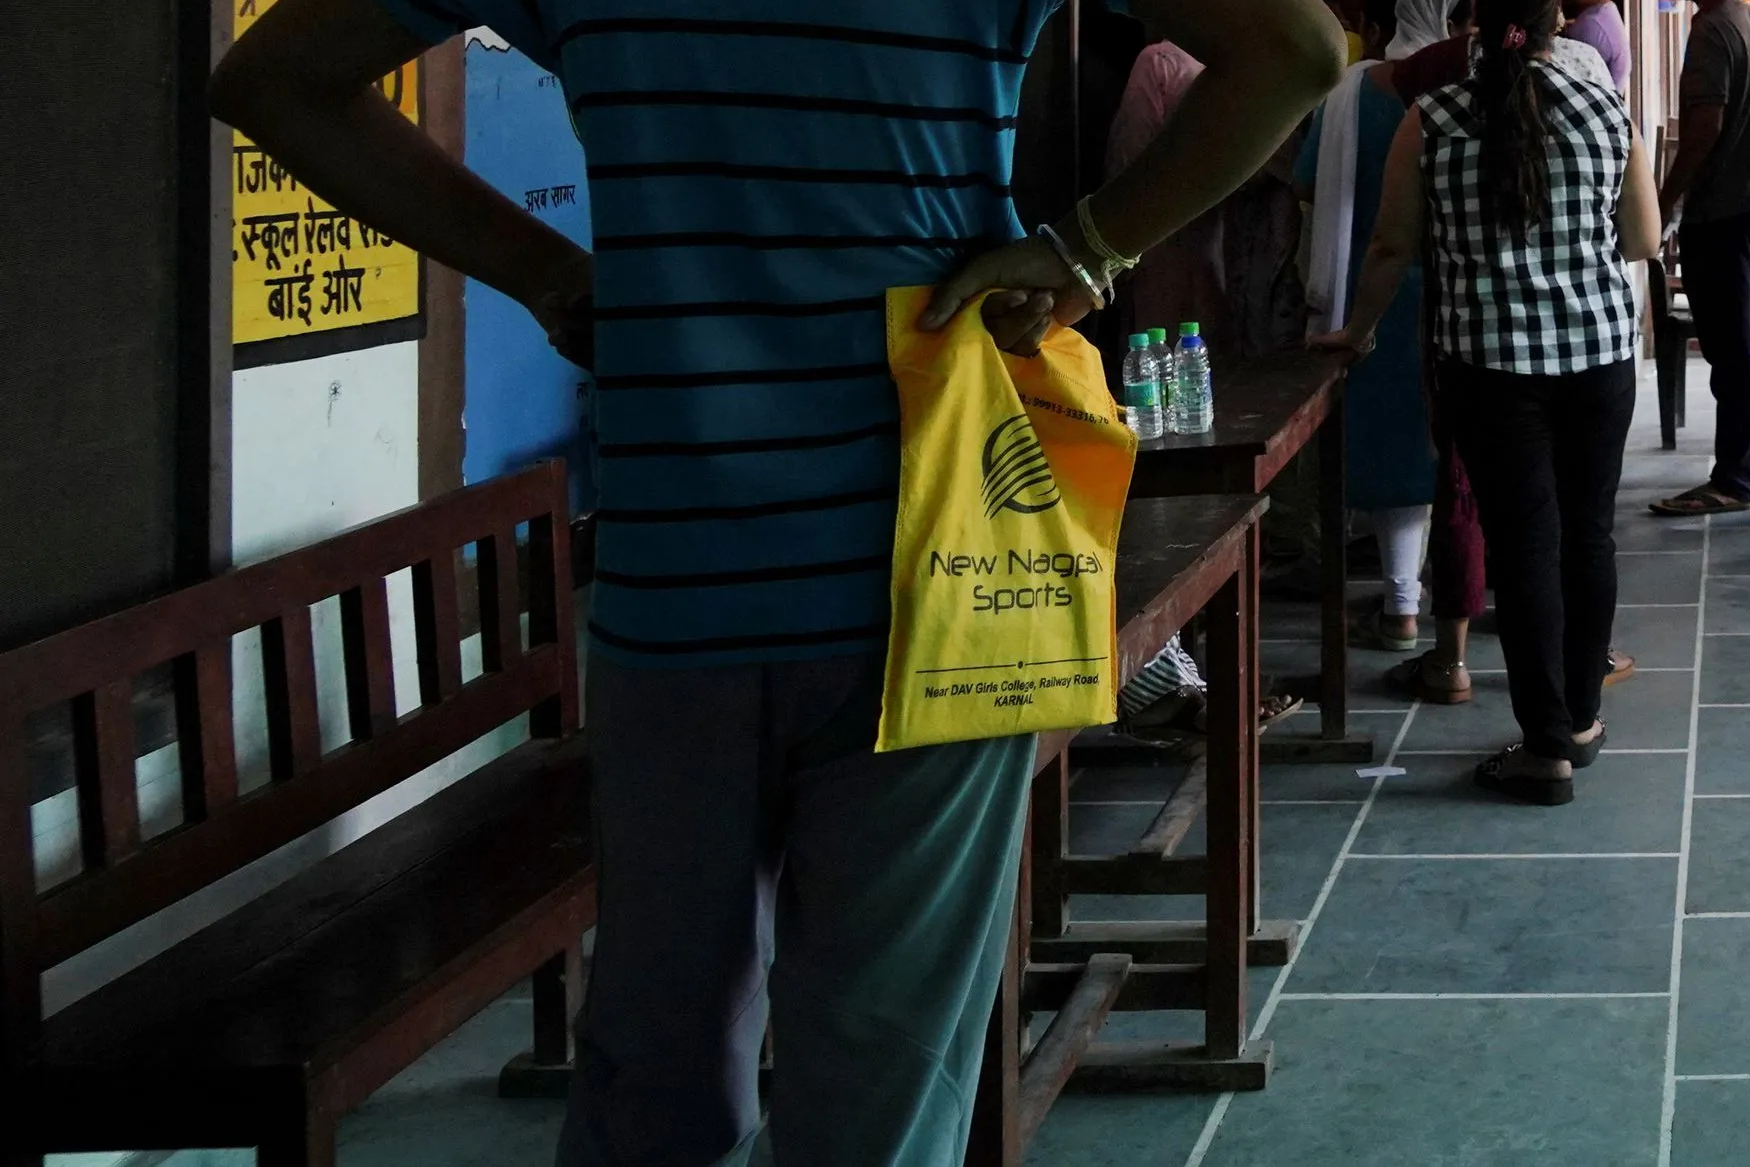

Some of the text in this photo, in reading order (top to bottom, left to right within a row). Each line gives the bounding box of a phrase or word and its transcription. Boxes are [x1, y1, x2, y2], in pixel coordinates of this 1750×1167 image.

[550, 184, 576, 205] सागर
[241, 211, 300, 270] स्कूल
[321, 254, 366, 315] ओर
[930, 550, 997, 577] New
[973, 582, 1073, 614] Sports
[925, 686, 949, 699] Near
[950, 683, 974, 696] DAV
[976, 681, 998, 694] Girls
[1001, 679, 1037, 693] College,
[1039, 676, 1072, 689] Railway
[994, 694, 1034, 708] KARNAL
